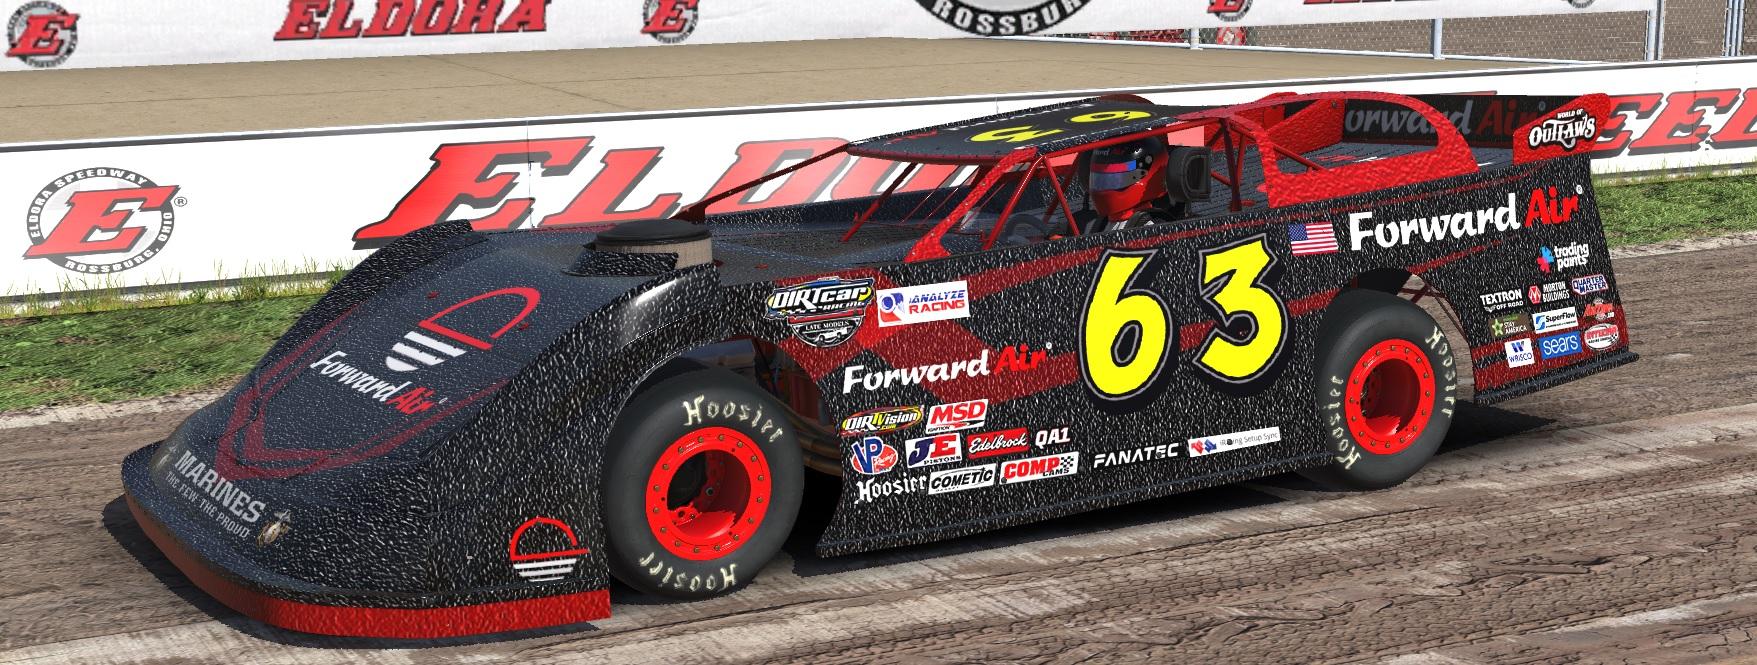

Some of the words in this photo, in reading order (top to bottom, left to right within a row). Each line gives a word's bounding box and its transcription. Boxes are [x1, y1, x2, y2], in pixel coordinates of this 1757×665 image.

[1557, 110, 1576, 119] WORLD
[1576, 108, 1584, 116] OF
[29, 189, 54, 240] ELDORA
[54, 168, 149, 188] SPEEDWAY
[157, 212, 173, 242] OHIO
[1349, 192, 1520, 251] Forward
[1524, 186, 1579, 227] Air
[1554, 242, 1589, 258] trading
[1557, 256, 1587, 271] paints
[1573, 275, 1604, 289] QUARTER
[1580, 280, 1608, 294] MASTER
[909, 300, 965, 314] RACING
[1480, 289, 1522, 305] TEXTRON
[1508, 300, 1524, 308] ROAD
[1543, 290, 1570, 303] BUILDINGS
[823, 320, 850, 329] MODELS
[1083, 236, 1284, 398] 63
[1546, 311, 1576, 323] SuperFlow
[1543, 335, 1579, 355] sears
[309, 350, 413, 402] Forward
[843, 349, 990, 394] Forward
[993, 344, 1047, 374] Air
[682, 395, 783, 442] Hoosier
[930, 401, 986, 424] MSD
[969, 432, 1028, 454] Edelbrock
[1035, 427, 1070, 449] QA1
[1263, 431, 1279, 441] Sync
[852, 436, 883, 474] VP
[908, 434, 957, 466] JE
[924, 456, 961, 465] PISTONS
[1093, 443, 1179, 468] FANATEC
[1004, 457, 1060, 479] COMP
[1043, 467, 1070, 477] CAMS
[175, 450, 266, 523] MARINES
[854, 472, 927, 504] Hoosier
[931, 469, 993, 490] COMETIC
[165, 471, 180, 489] THE
[199, 498, 218, 518] THE
[215, 511, 251, 539] PROUD
